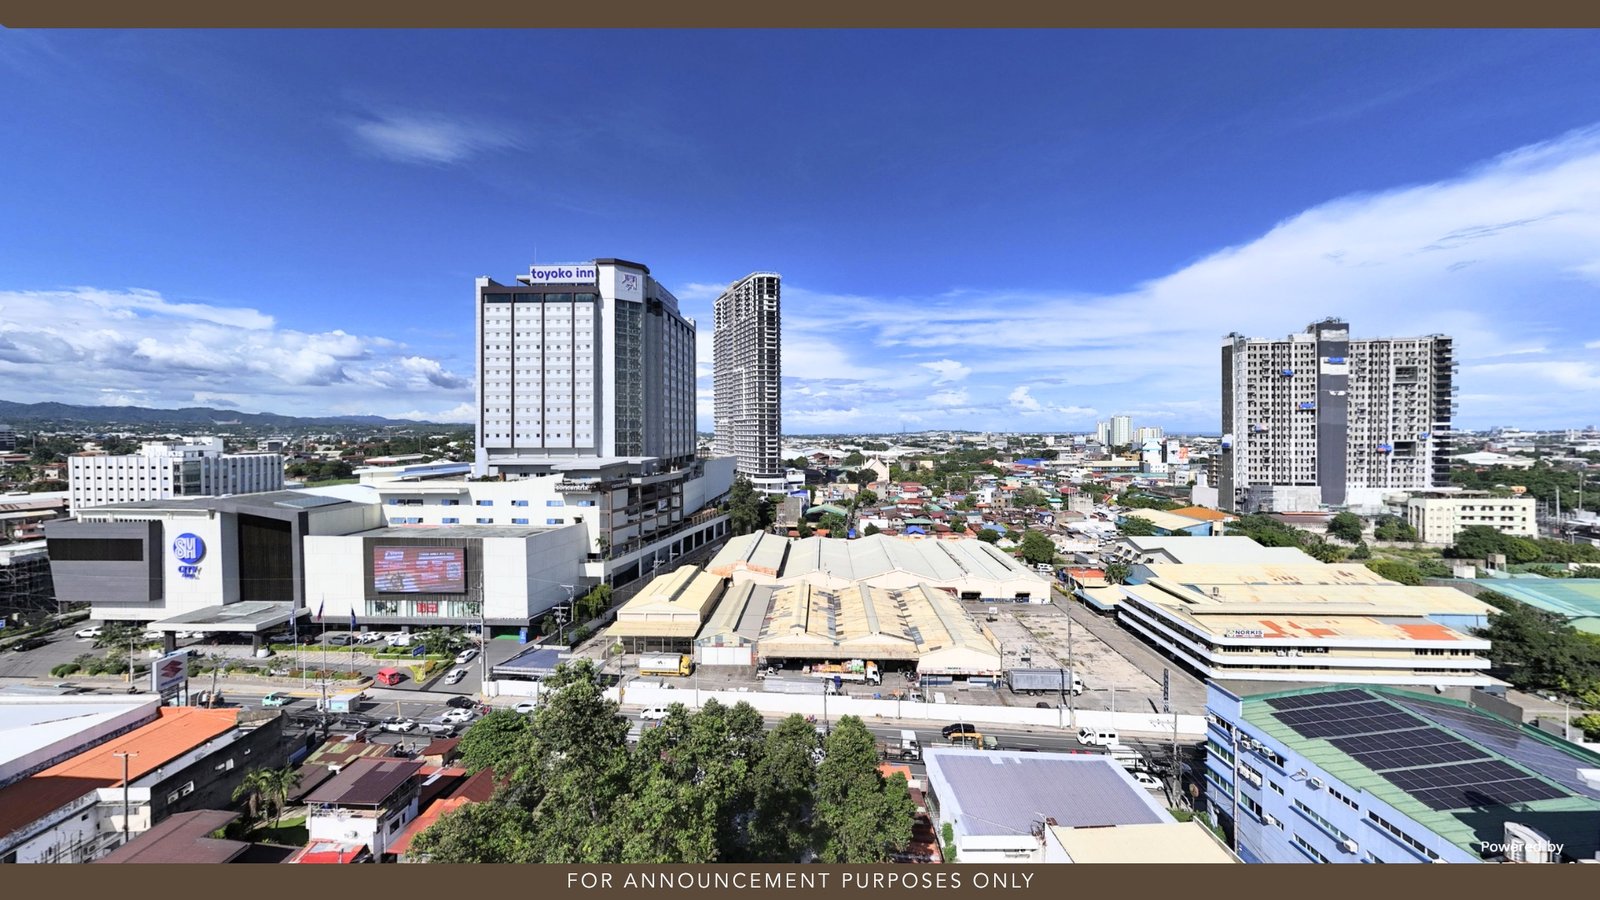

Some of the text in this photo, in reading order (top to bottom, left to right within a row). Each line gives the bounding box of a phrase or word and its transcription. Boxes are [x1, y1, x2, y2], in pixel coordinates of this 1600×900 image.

[531, 267, 594, 280] toyoko inn
[174, 537, 196, 559] SM
